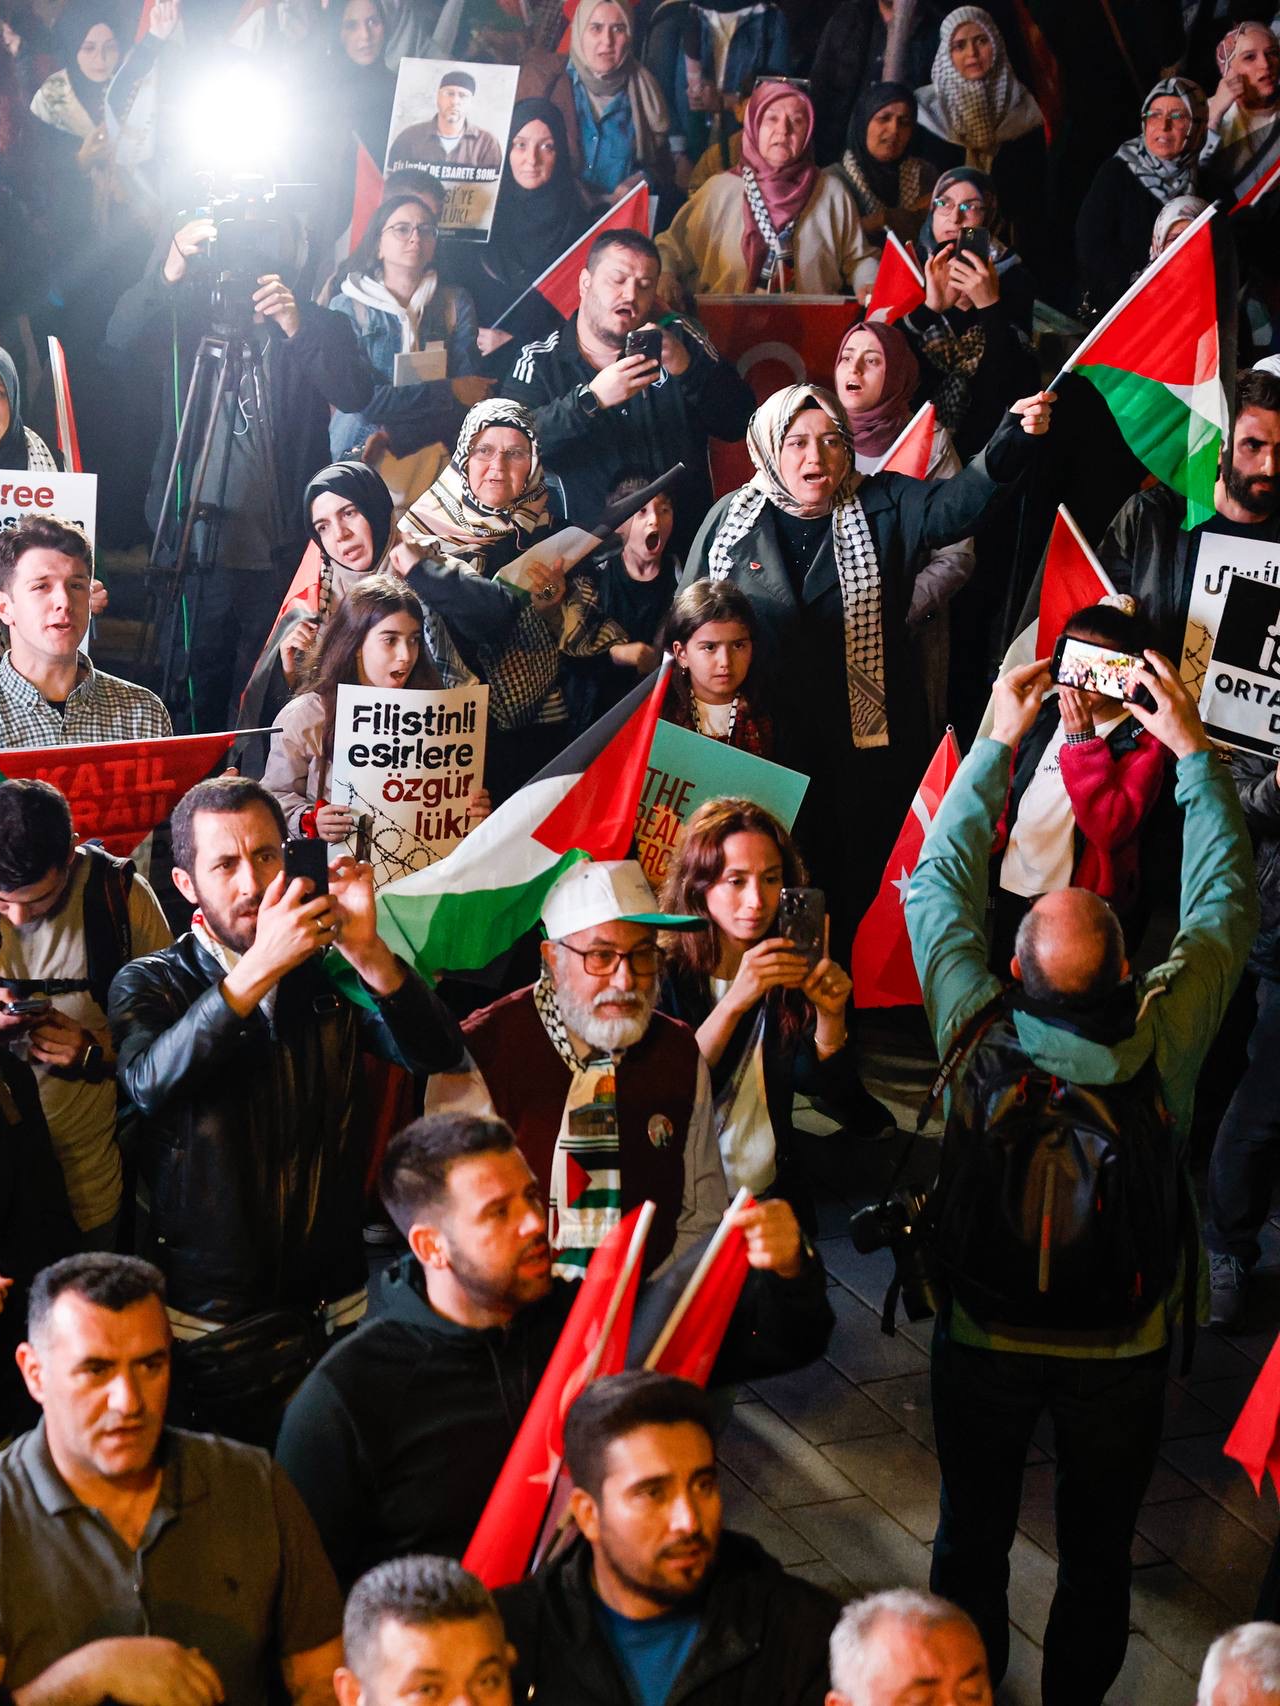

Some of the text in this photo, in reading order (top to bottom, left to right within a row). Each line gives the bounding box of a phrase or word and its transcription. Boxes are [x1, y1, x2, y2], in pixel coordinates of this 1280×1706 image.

[441, 166, 475, 180] ESARETE
[353, 701, 476, 736] Filistinli
[348, 737, 474, 770] esirlere
[382, 769, 474, 809] özgür
[641, 766, 696, 818] THE
[415, 808, 471, 842] lük!
[634, 802, 677, 848] REAL
